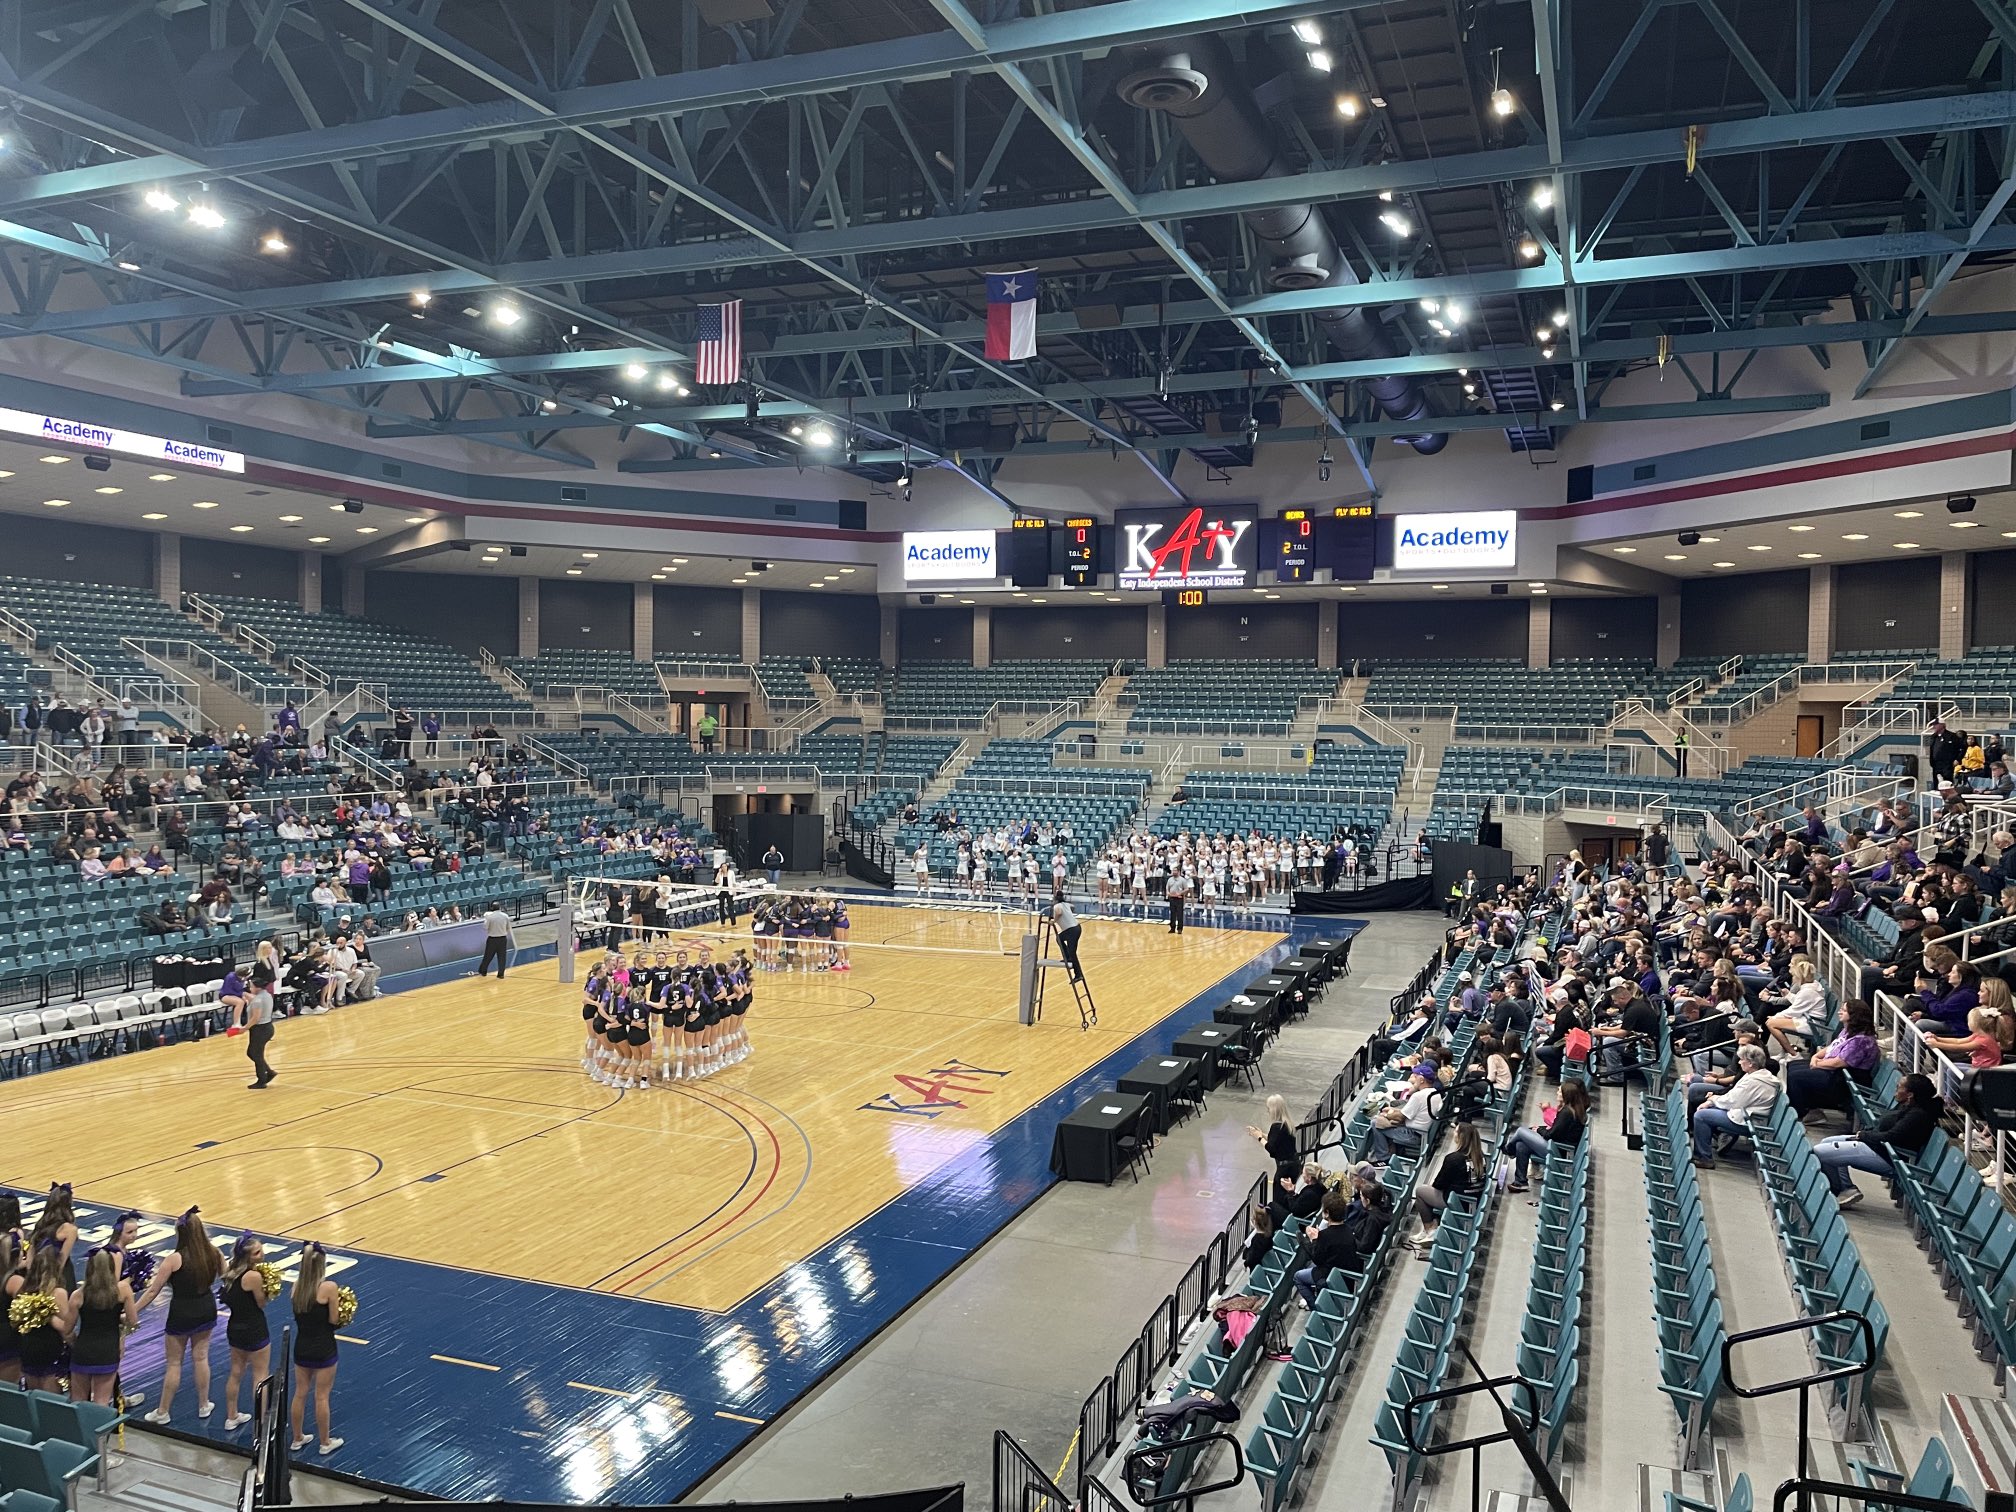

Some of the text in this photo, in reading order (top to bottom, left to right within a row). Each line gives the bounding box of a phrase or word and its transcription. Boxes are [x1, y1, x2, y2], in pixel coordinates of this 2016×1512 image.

[43, 418, 113, 446] Academy
[164, 441, 225, 466] Academy
[1077, 528, 1086, 542] 0
[1301, 521, 1310, 535] 0
[1400, 527, 1509, 550] Academy
[907, 544, 990, 564] Academy
[1083, 548, 1090, 559] 2
[1283, 542, 1291, 554] 2
[1120, 576, 1244, 590] Katy Independent School District
[1179, 591, 1203, 605] 1:00
[1240, 617, 1248, 625] N
[672, 990, 680, 1001] 5
[632, 1008, 640, 1019] 6
